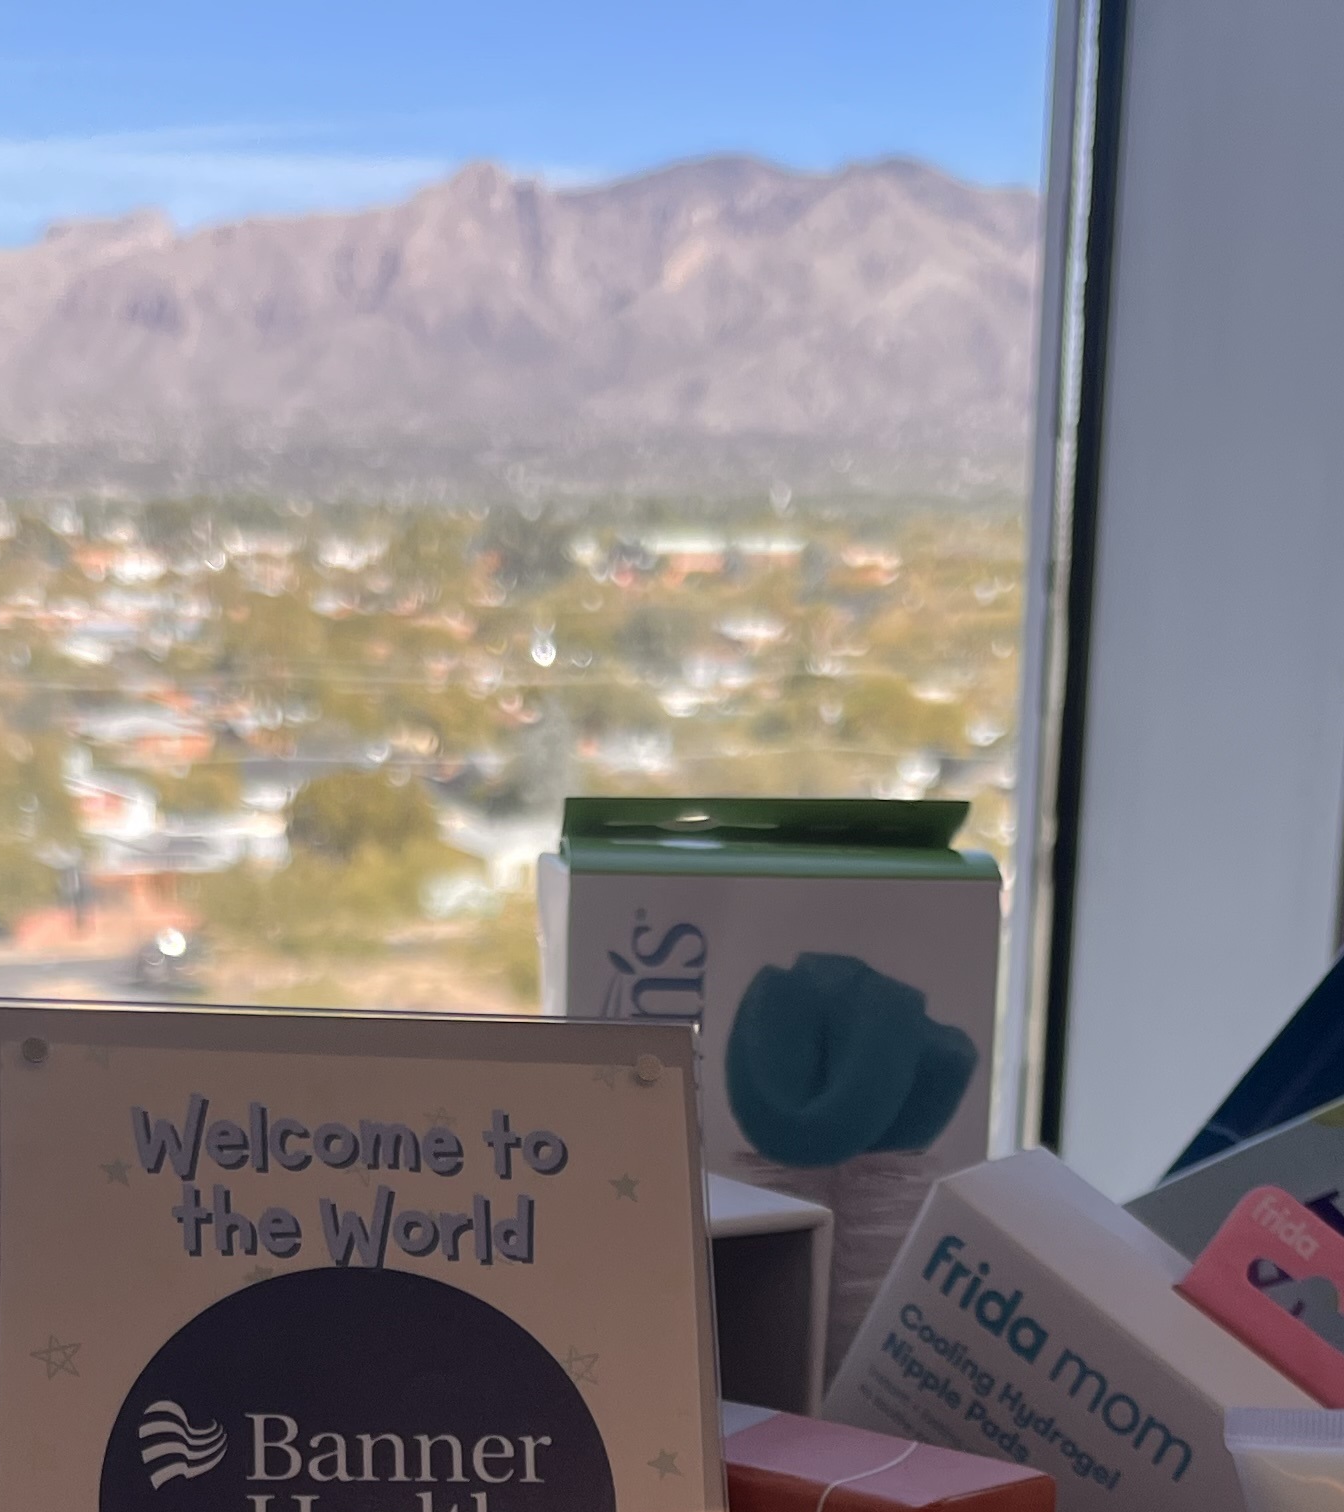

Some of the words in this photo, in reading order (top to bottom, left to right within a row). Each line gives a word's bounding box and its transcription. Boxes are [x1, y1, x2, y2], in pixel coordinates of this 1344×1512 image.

[131, 1092, 465, 1182] Welcome
[483, 1108, 568, 1180] to
[172, 1183, 302, 1258] the
[319, 1185, 536, 1269] World
[1253, 1190, 1321, 1263] frida
[881, 1331, 964, 1412] Nipple
[962, 1396, 1034, 1464] Pads
[899, 1302, 996, 1398] Cooling
[997, 1381, 1124, 1493] Hydrogel
[921, 1234, 1052, 1367] frida
[1048, 1345, 1195, 1484] mom
[245, 1412, 553, 1485] Banner
